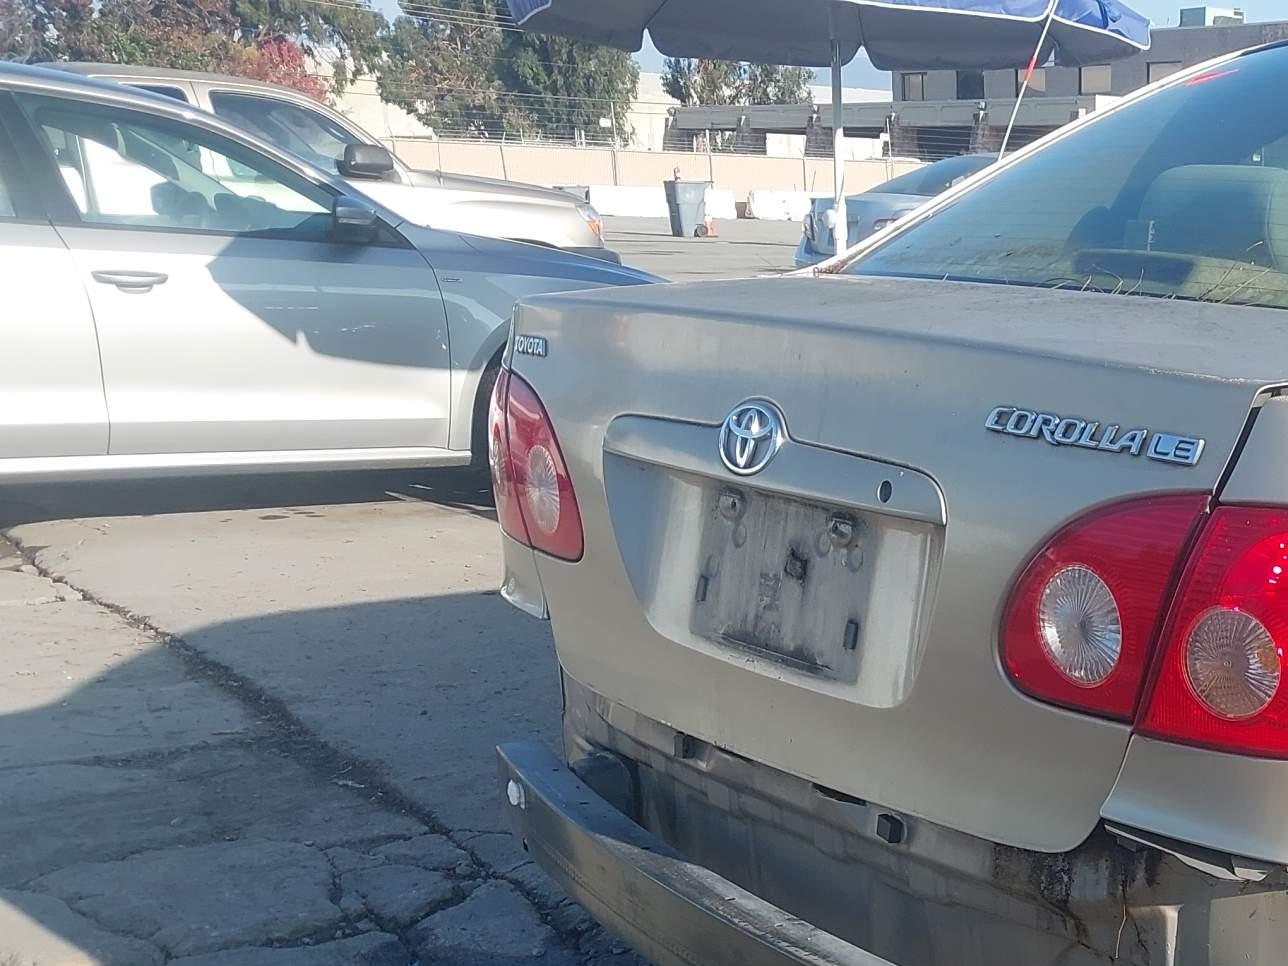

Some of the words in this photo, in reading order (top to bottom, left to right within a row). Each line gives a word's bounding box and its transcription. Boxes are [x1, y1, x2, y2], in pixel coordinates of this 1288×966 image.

[514, 335, 544, 355] TOYOTA
[984, 406, 1148, 457] COROLLA
[1151, 433, 1200, 463] LE
